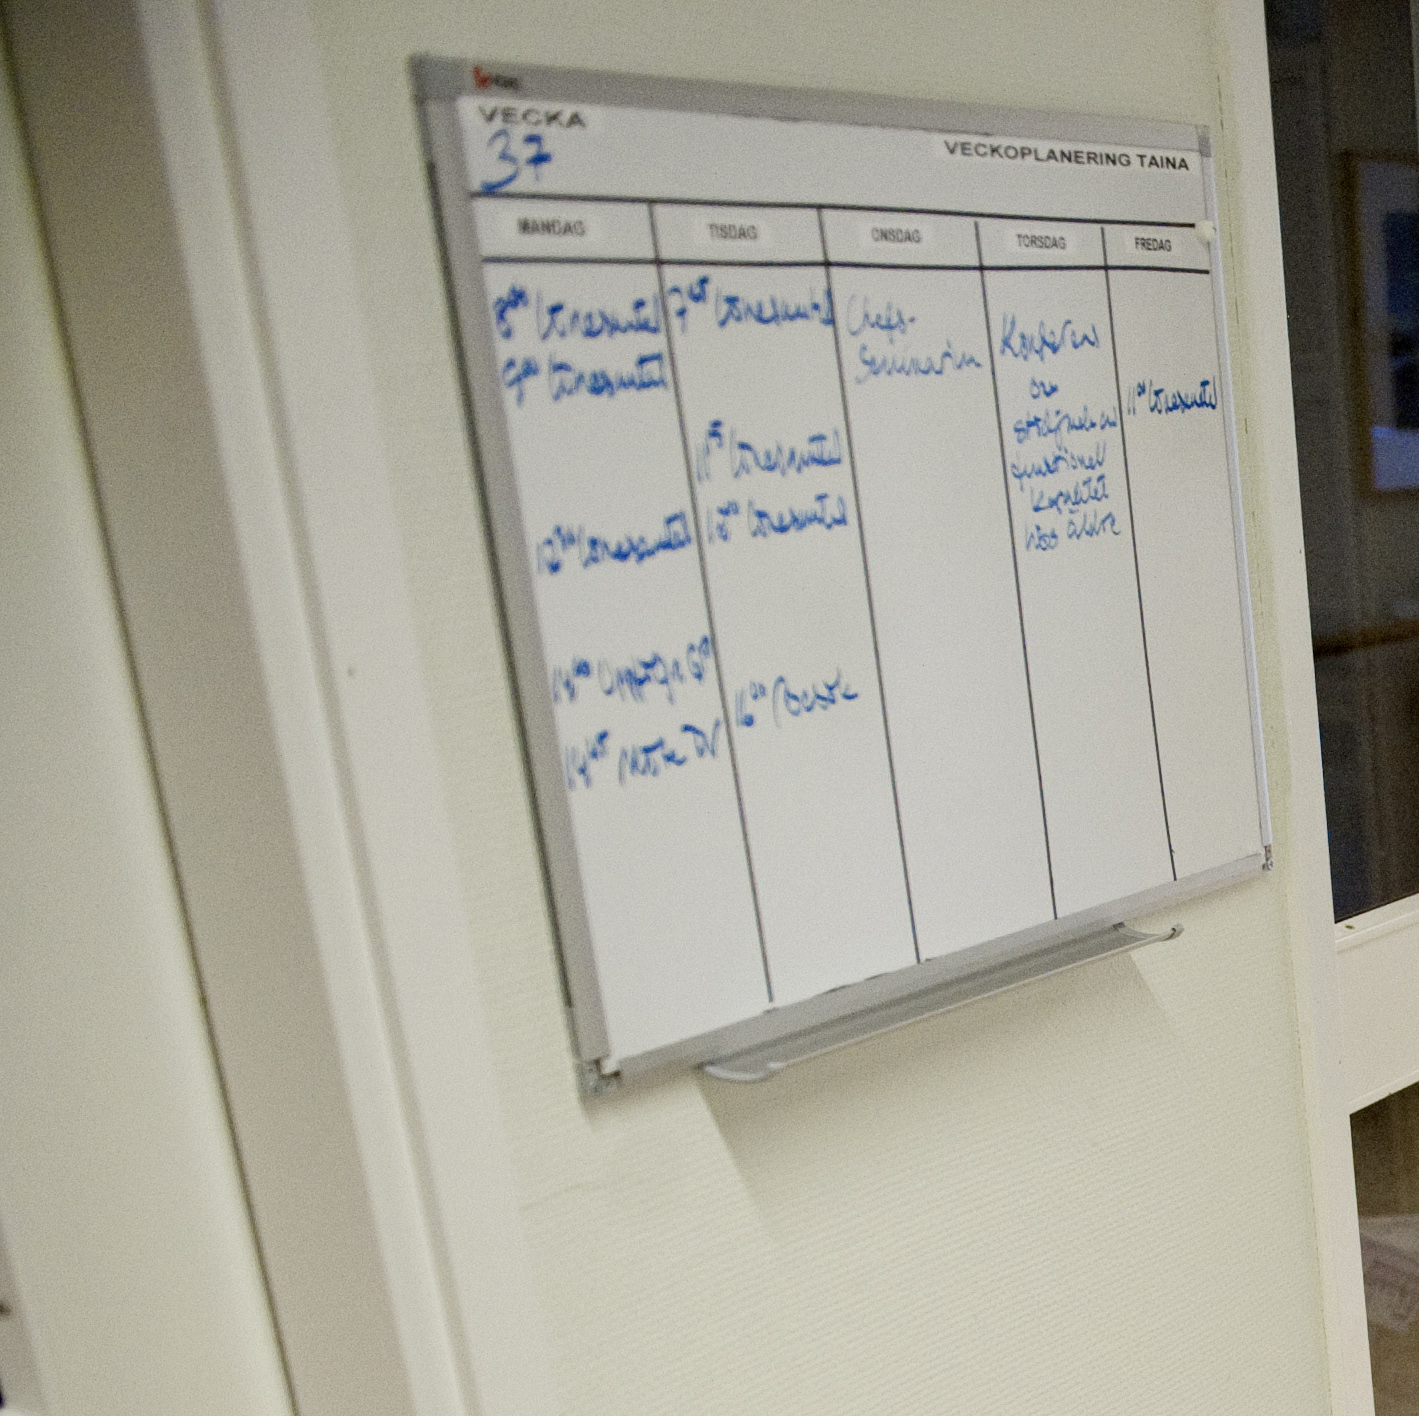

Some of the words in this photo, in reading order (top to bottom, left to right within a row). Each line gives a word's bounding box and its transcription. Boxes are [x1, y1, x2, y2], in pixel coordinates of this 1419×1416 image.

[478, 105, 587, 128] VECKA
[480, 128, 553, 193] 37
[944, 139, 1131, 167] VECKOPLANERING
[1137, 154, 1190, 171] TAINA
[709, 223, 758, 240] TISDAG
[871, 227, 922, 243] ONSDAG
[1016, 233, 1067, 250] TORSDAG
[1134, 237, 1172, 252] FREDAG
